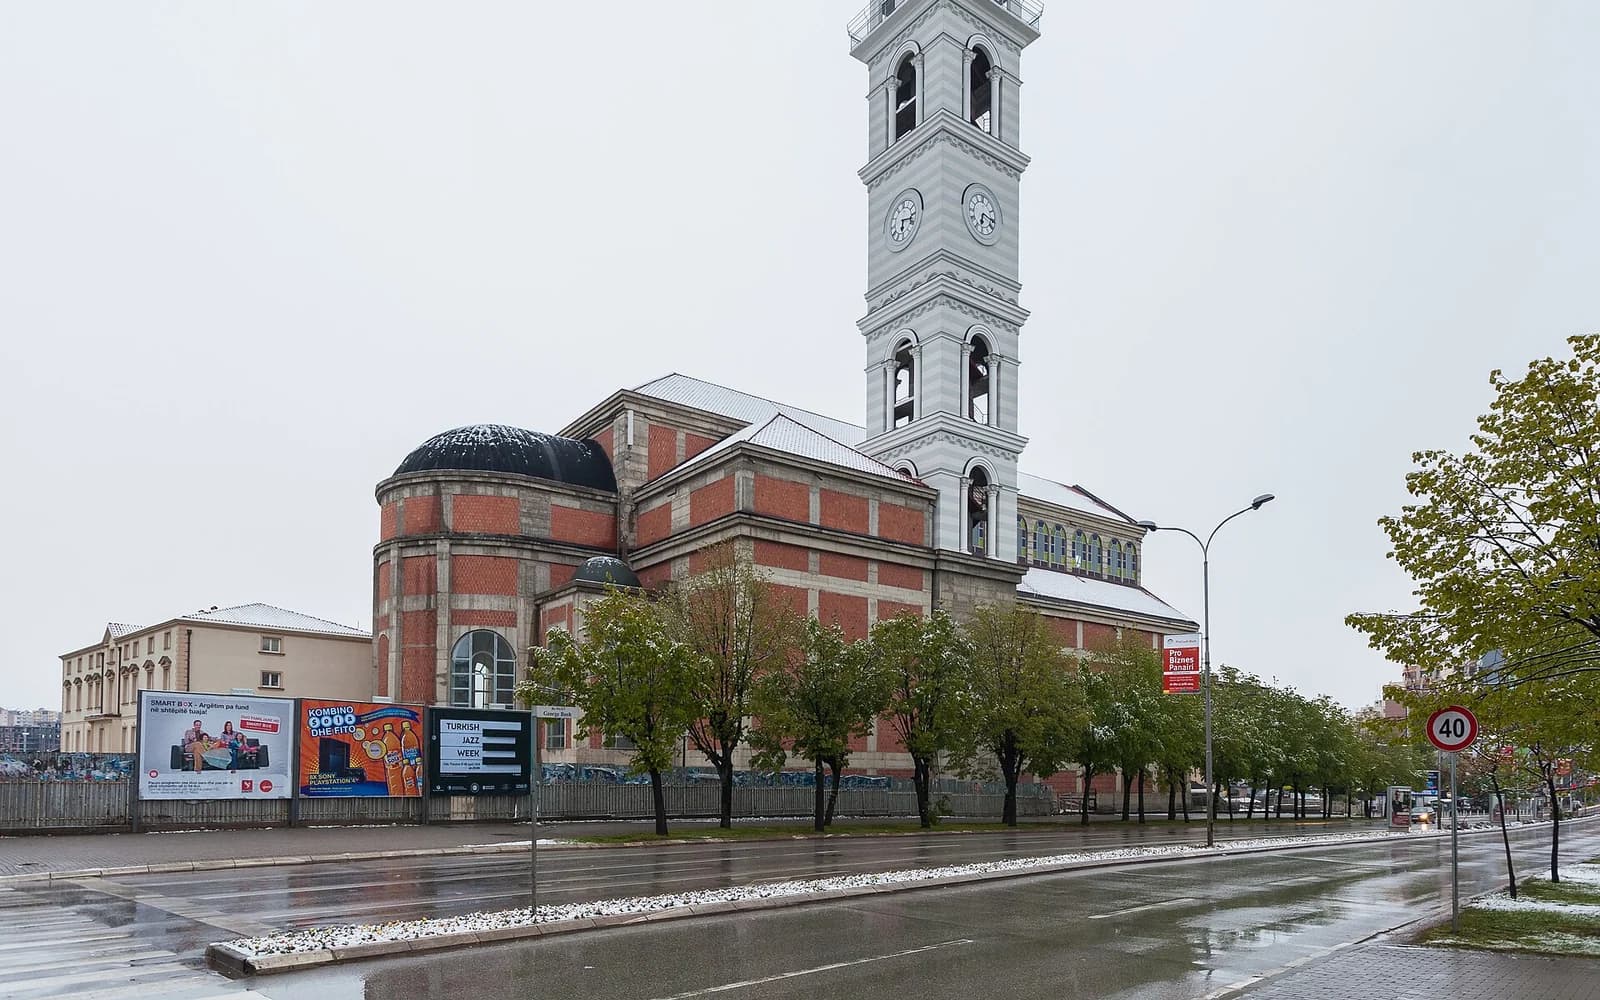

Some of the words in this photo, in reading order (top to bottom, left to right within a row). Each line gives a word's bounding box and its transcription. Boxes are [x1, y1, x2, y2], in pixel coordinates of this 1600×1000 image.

[308, 706, 354, 717] KOMBINO
[311, 727, 332, 737] DHE
[334, 725, 356, 734] FITO
[1439, 718, 1465, 738] 40
